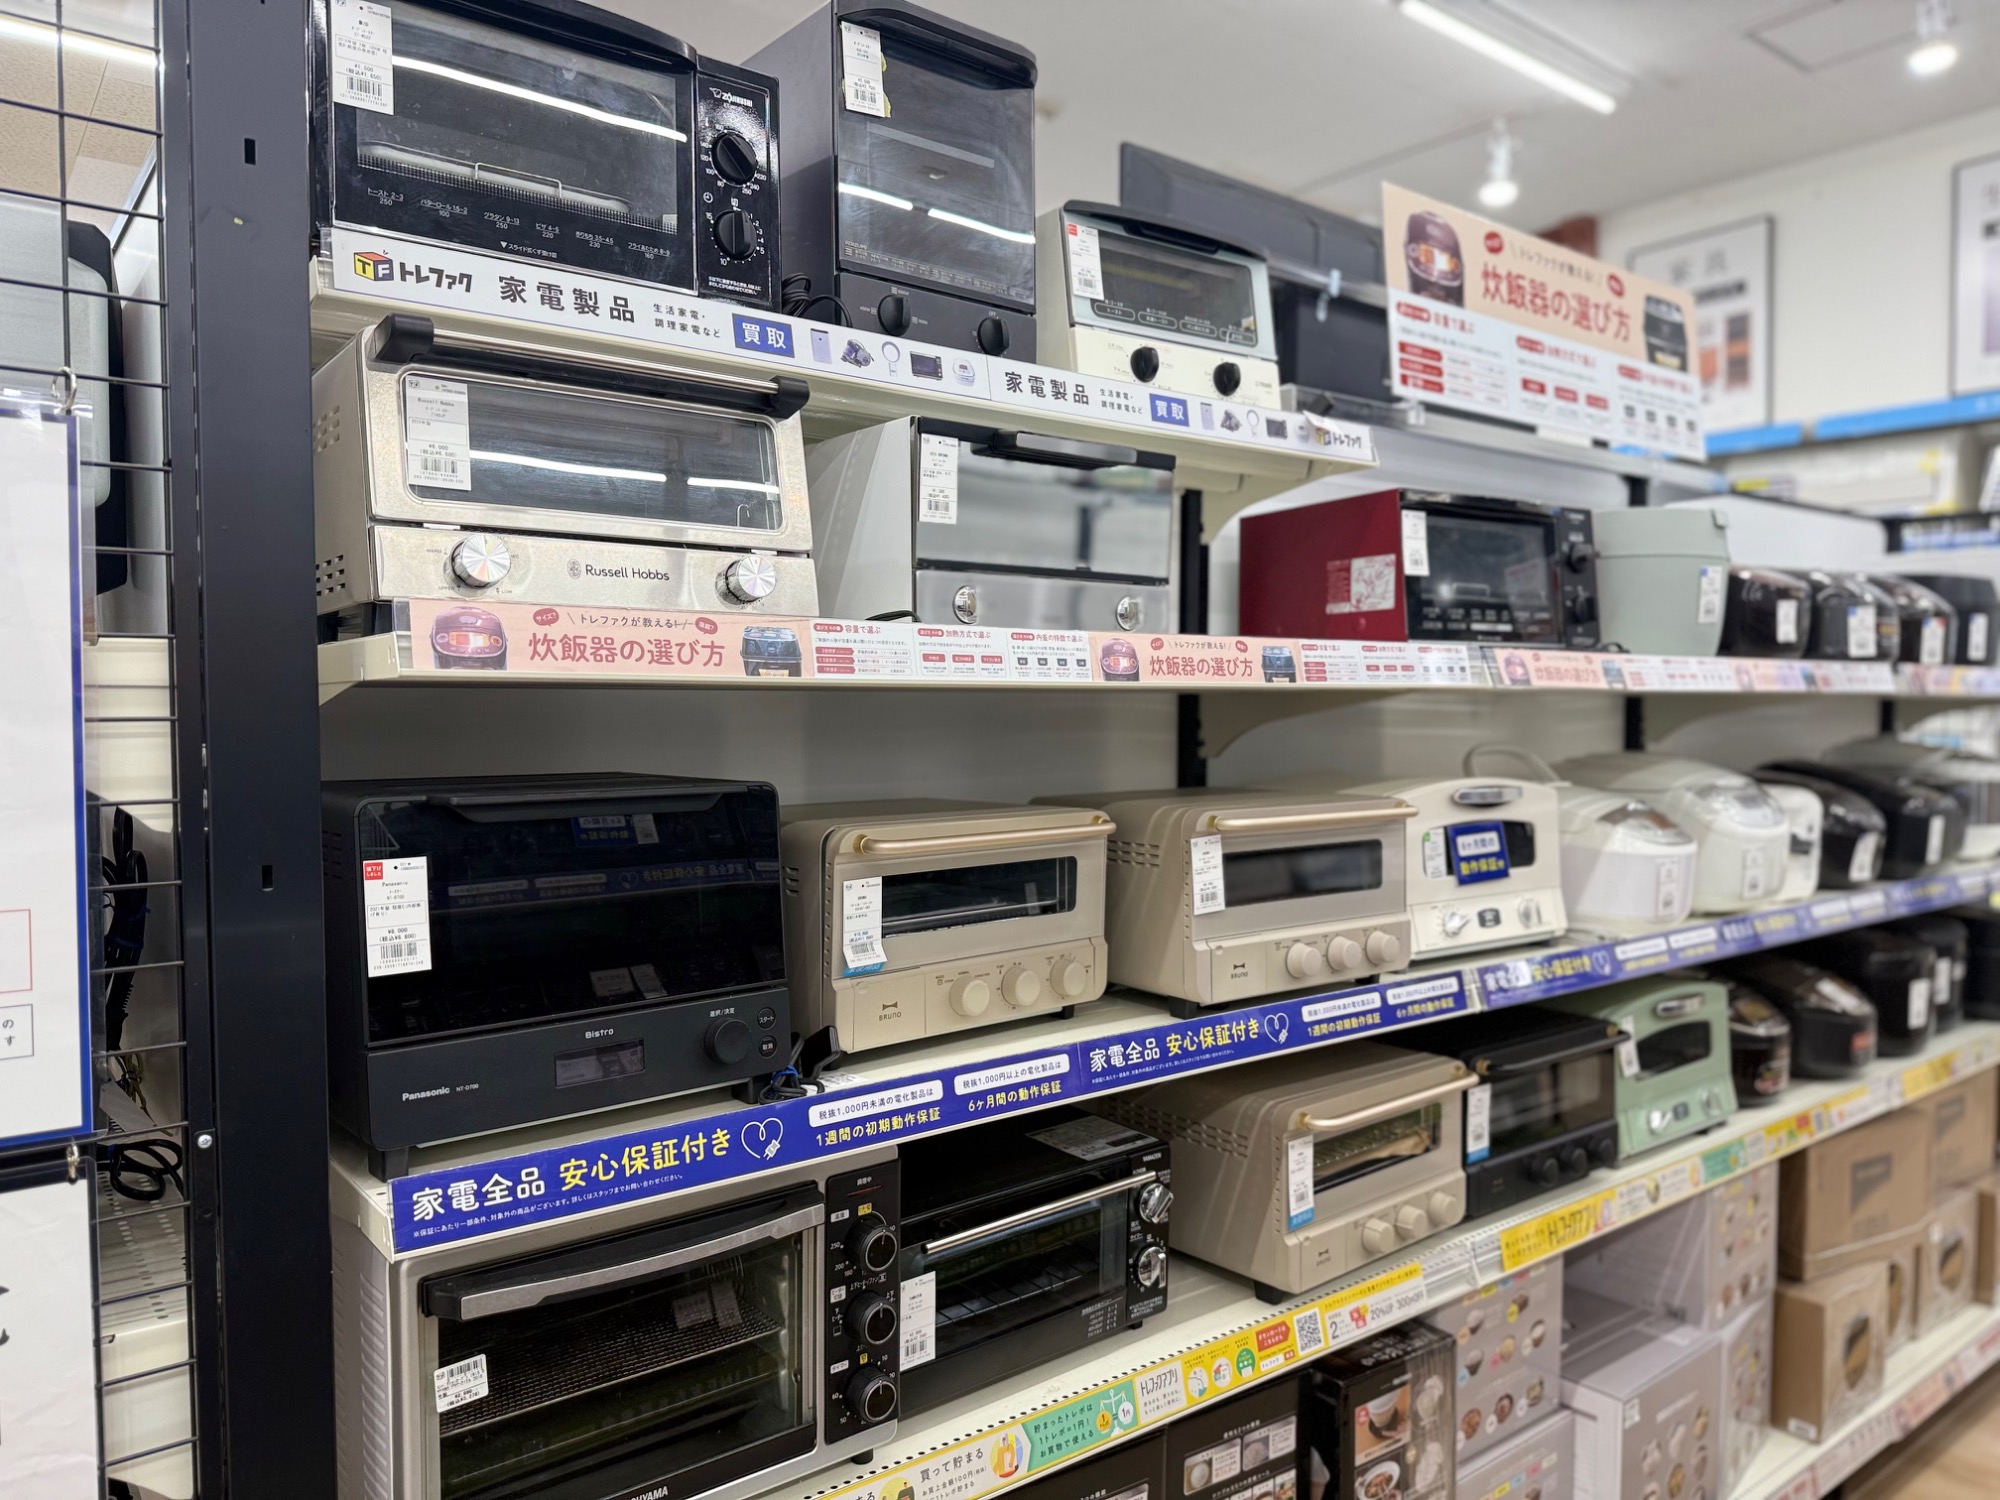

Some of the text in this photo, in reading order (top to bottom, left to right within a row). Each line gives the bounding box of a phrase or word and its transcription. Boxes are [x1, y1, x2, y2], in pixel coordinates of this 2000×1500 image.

[721, 92, 753, 107] ZOJIRUSHI
[705, 168, 715, 176] 100
[368, 187, 389, 196] トースト
[379, 198, 393, 206] 250
[438, 210, 450, 218] 100
[484, 212, 505, 222] グラタン
[496, 222, 508, 230] 250
[588, 240, 600, 248] 230
[720, 258, 728, 266] 10
[400, 262, 472, 293] トレファク
[498, 276, 635, 323] 家電製品
[1481, 261, 1632, 343] 炊飯器の選び方
[654, 317, 721, 339] 調理家電など
[741, 322, 787, 349] 買取
[1004, 371, 1090, 406] 家電製品
[1155, 400, 1185, 421] 買取
[1332, 428, 1362, 449] トレファク
[584, 564, 670, 582] Russell Hobbs
[844, 624, 882, 634] 容量で選ぶ
[946, 630, 992, 638] 加熱方式で選ぶ
[528, 632, 726, 668] 炊飯器の選び方
[1150, 655, 1253, 677] 炊飯器の選び方
[1230, 971, 1249, 979] BRUNO
[709, 1008, 736, 1018] 選択/決定
[759, 1016, 774, 1024] スタート
[878, 1011, 902, 1022] BRUNO
[2, 1019, 14, 1029] の
[1307, 1012, 1381, 1037] 1週間の初期動作保証
[4, 1035, 16, 1046] す
[585, 1028, 614, 1039] Bistro
[1090, 1018, 1260, 1073] 家電全品 安心保証付き
[962, 1060, 1062, 1090] 税抜1,000円以上の電化製品は
[402, 1083, 479, 1101] Panasonic NT-D700
[968, 1080, 1062, 1112] 6ヶ月間の動作保証
[819, 1088, 934, 1120] 税抜1,000円未満の電化製品は
[816, 1107, 941, 1146] 1週間の初期動作保証
[1142, 1153, 1162, 1162] YAMAZEN
[412, 1128, 731, 1221] 家電全品 安心保証付き
[857, 1176, 872, 1186] 調理中
[1130, 1233, 1143, 1241] タイマー
[830, 1242, 840, 1250] 250
[835, 1263, 844, 1271] 200
[1258, 1326, 1286, 1340] ダウンロードは
[1330, 1321, 1339, 1339] 2
[1264, 1335, 1284, 1346] こちらから
[832, 1362, 848, 1372] タイマー
[1140, 1368, 1178, 1397] トレファクアプリ
[1033, 1403, 1093, 1434] 貯まったトレポは
[1122, 1408, 1131, 1418] 1円
[1040, 1431, 1094, 1458] お買物で使える
[920, 1448, 984, 1483] 買って貯まる
